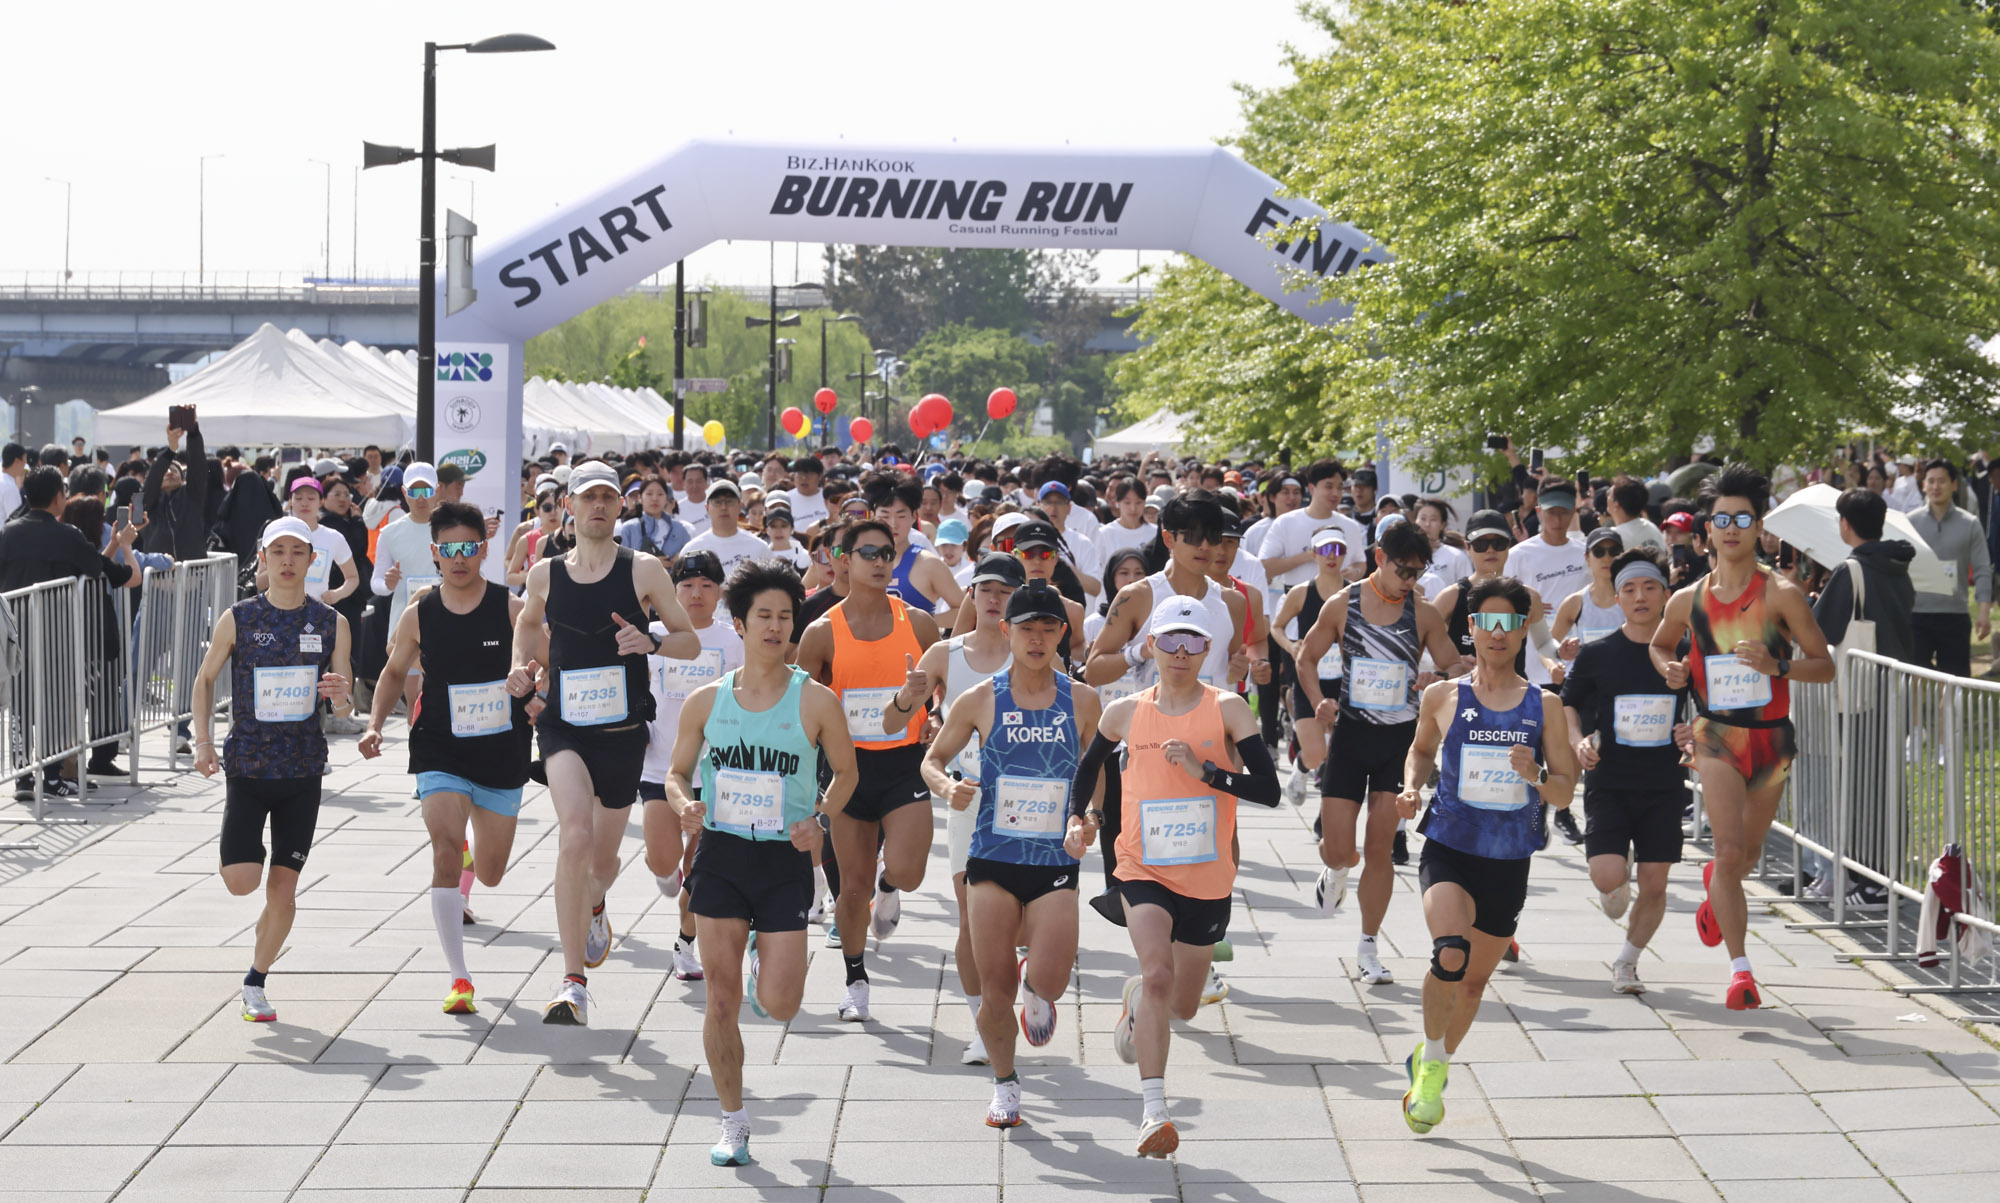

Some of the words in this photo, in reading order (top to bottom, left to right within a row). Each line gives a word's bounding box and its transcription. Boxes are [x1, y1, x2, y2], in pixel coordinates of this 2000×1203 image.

[769, 174, 1007, 221] BURNING
[1015, 181, 1134, 223] RUN
[948, 224, 996, 234] Casual
[1000, 224, 1060, 238] Running
[1064, 225, 1118, 236] Festival
[499, 184, 673, 308] START
[668, 666, 677, 674] M
[679, 665, 715, 677] 7256
[1367, 679, 1401, 689] 7364
[1724, 672, 1761, 686] 7140
[262, 689, 271, 697] M
[274, 686, 310, 698] 7408
[568, 692, 577, 701] M
[580, 686, 617, 702] 7335
[457, 705, 466, 713] M
[468, 700, 504, 715] 7110
[849, 709, 858, 717] M
[1632, 713, 1667, 724] 7268
[1006, 727, 1066, 743] KOREA
[1469, 729, 1529, 743] DESCENTE
[709, 735, 755, 771] GWAN
[758, 745, 800, 776] WOO
[1468, 770, 1479, 780] M
[720, 791, 730, 800] M
[732, 791, 774, 808] 7395
[1003, 799, 1014, 808] M
[1016, 799, 1058, 814] 7269
[757, 819, 778, 827] B-27
[1149, 826, 1160, 836] M
[1162, 821, 1208, 838] 7254
